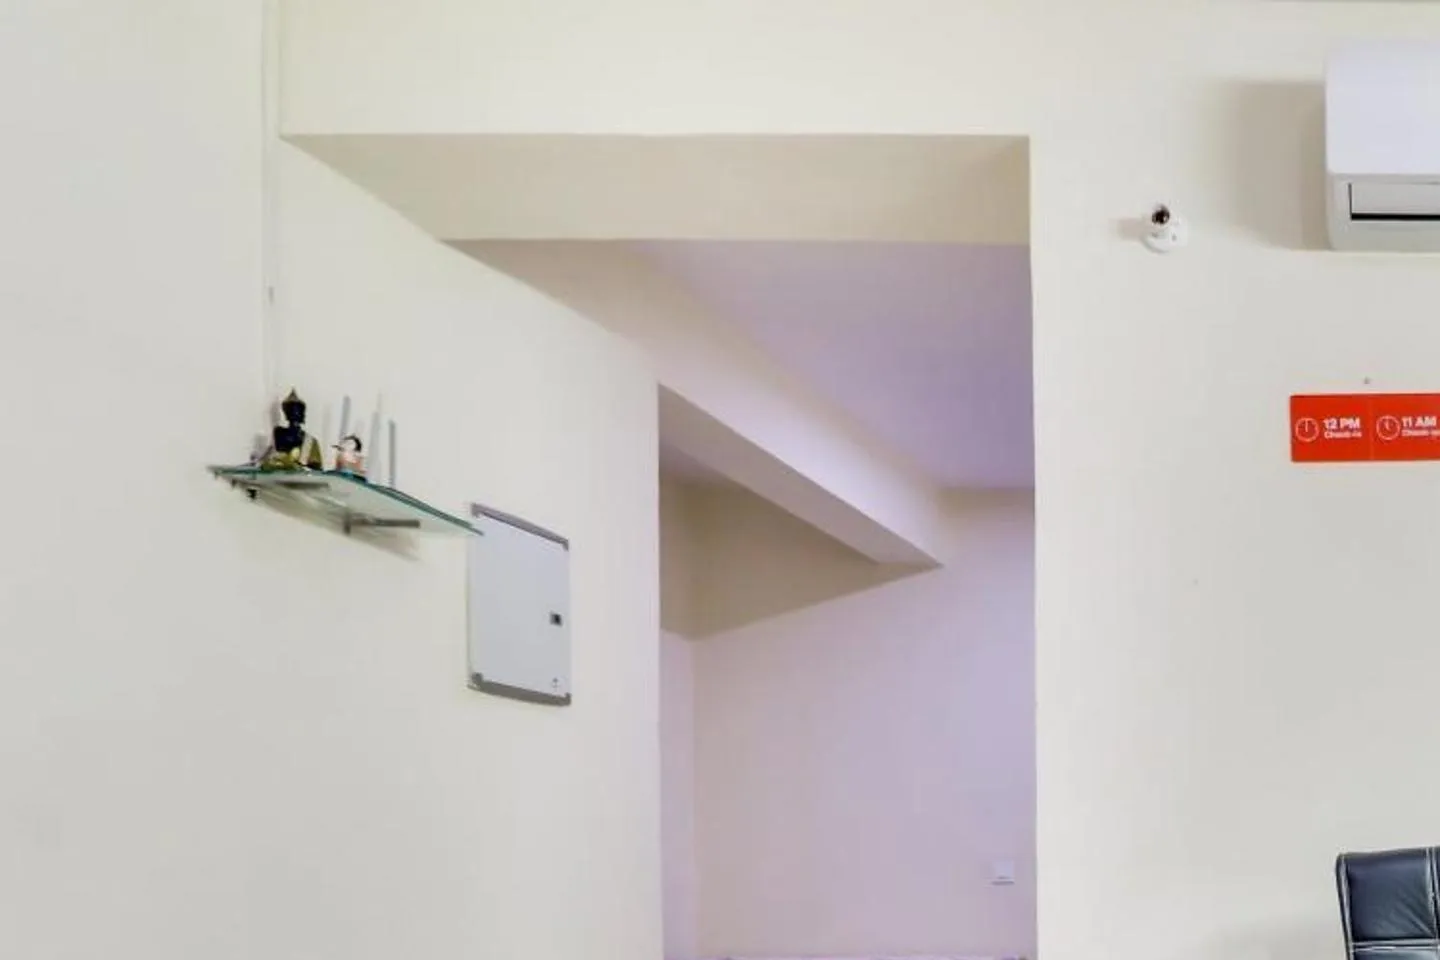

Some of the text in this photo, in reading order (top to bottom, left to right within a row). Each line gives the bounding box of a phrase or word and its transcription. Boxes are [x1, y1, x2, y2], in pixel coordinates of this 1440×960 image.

[1324, 417, 1361, 429] 12 PM
[1402, 416, 1437, 427] 11 AM
